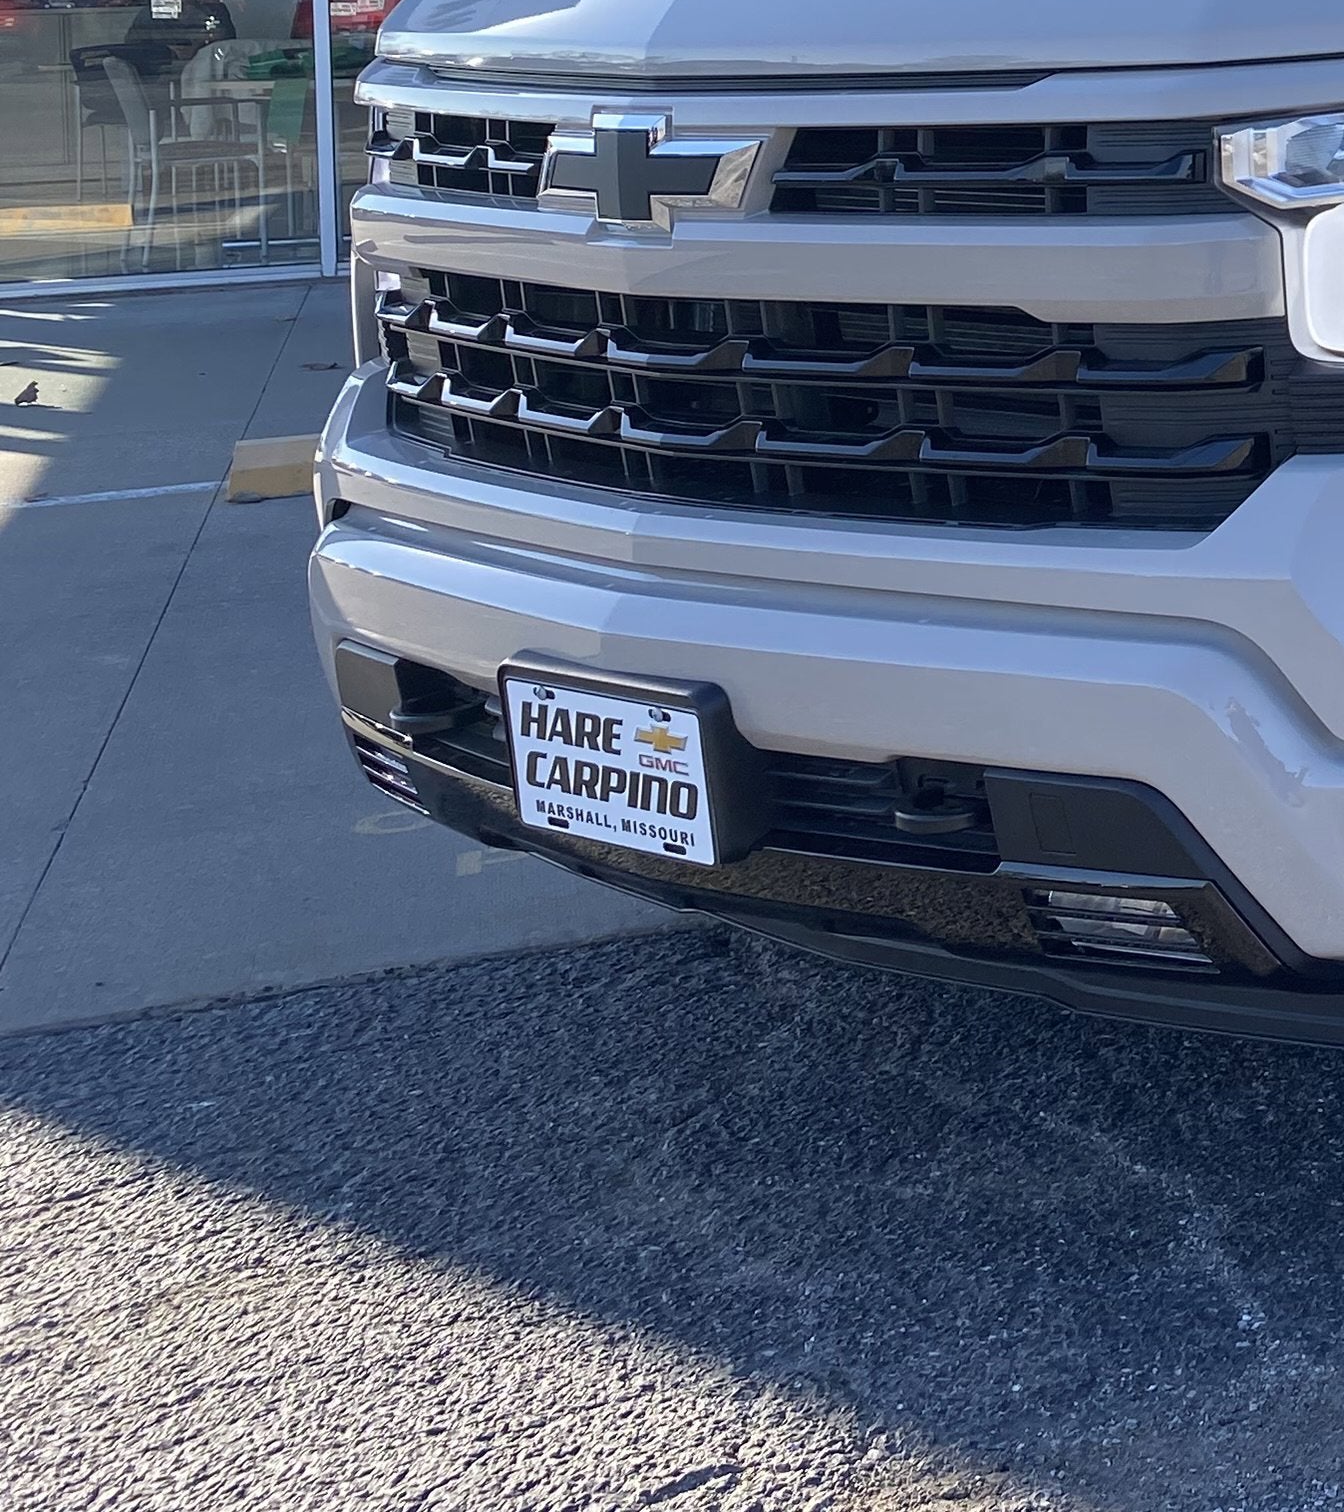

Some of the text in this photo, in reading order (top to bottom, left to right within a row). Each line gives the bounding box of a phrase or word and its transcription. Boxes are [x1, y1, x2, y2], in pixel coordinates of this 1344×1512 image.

[520, 701, 623, 755] HARE
[525, 750, 699, 821] CARPINO
[638, 754, 689, 776] GMC
[535, 799, 696, 847] MARSHALL, MISSOURI
